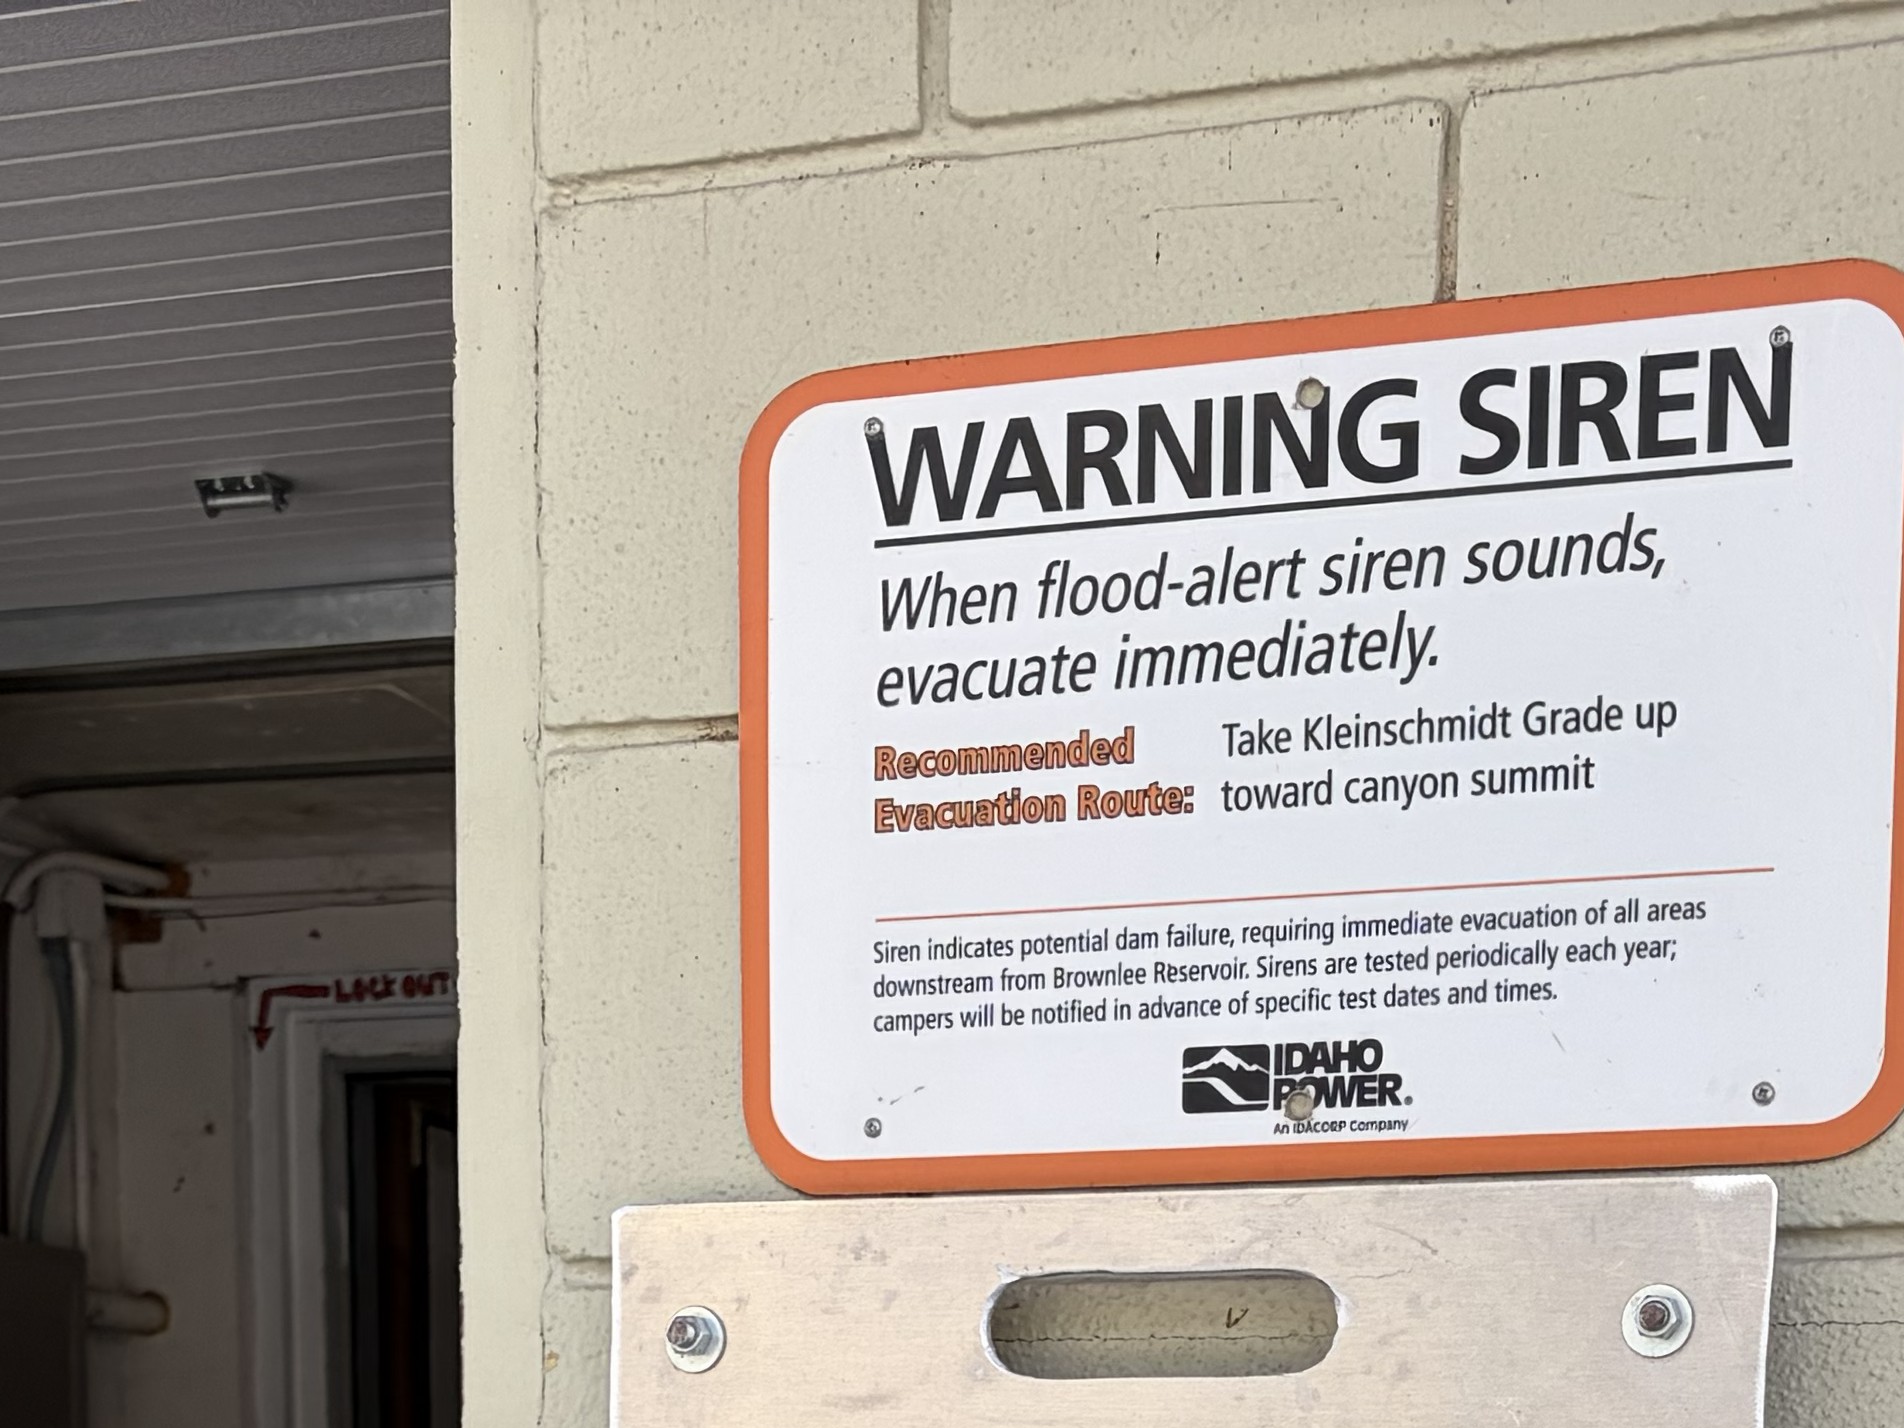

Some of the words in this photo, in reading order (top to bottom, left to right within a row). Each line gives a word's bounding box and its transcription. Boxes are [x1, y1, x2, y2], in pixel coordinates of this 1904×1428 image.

[865, 378, 1419, 528] WARNING
[1458, 341, 1792, 476] SIREN
[879, 570, 1017, 633] When
[1036, 545, 1306, 623] flood-alert
[1318, 537, 1446, 600] siren
[1463, 512, 1668, 588] sounds,
[877, 651, 1096, 707] evacuate
[1114, 611, 1440, 692] immediately.
[875, 727, 1135, 781] Recommended
[1222, 721, 1296, 759] Take
[1302, 705, 1512, 754] Kleinschmidt
[1522, 699, 1625, 738] Grade
[1633, 697, 1678, 739] up
[875, 786, 1066, 833] Evacuation
[1078, 780, 1195, 824] Route:
[1221, 772, 1336, 814] toward
[1344, 768, 1461, 815] canyon
[1470, 756, 1596, 797] summit
[873, 940, 921, 964] Siren
[928, 936, 1014, 960] indicates
[1021, 928, 1109, 962] potential
[1116, 926, 1159, 951] dam
[1167, 923, 1235, 949] failure,
[1242, 914, 1334, 950] requiring
[1342, 910, 1453, 939] immediate
[1461, 904, 1577, 933] evacuation
[1586, 900, 1607, 926] of
[1614, 898, 1639, 923] all
[1647, 899, 1706, 921] areas
[335, 975, 397, 1002] LOCK
[403, 972, 449, 998] OUT
[873, 972, 994, 998] downstream
[1001, 968, 1045, 992] from
[1054, 962, 1146, 989] Brownlee
[1154, 957, 1250, 983] Reservoir.
[1257, 955, 1317, 978] Sirens
[1324, 954, 1357, 976] are
[1365, 946, 1428, 973] tested
[1436, 939, 1558, 975] periodically
[1566, 936, 1616, 962] each
[1624, 939, 1676, 966] year;
[873, 1012, 953, 1037] campers
[960, 1004, 994, 1027] will
[1002, 1003, 1024, 1026] be
[1032, 998, 1106, 1024] notified
[1114, 997, 1131, 1021] in
[1139, 993, 1221, 1019] advance
[1229, 991, 1249, 1015] of
[1255, 986, 1331, 1018] specific
[1339, 986, 1377, 1010] test
[1384, 982, 1440, 1008] dates
[1448, 979, 1487, 1004] and
[1495, 976, 1557, 1002] times.
[1274, 1039, 1383, 1075] IDAHO
[1274, 1123, 1289, 1134] An
[1350, 1118, 1408, 1133] Company
